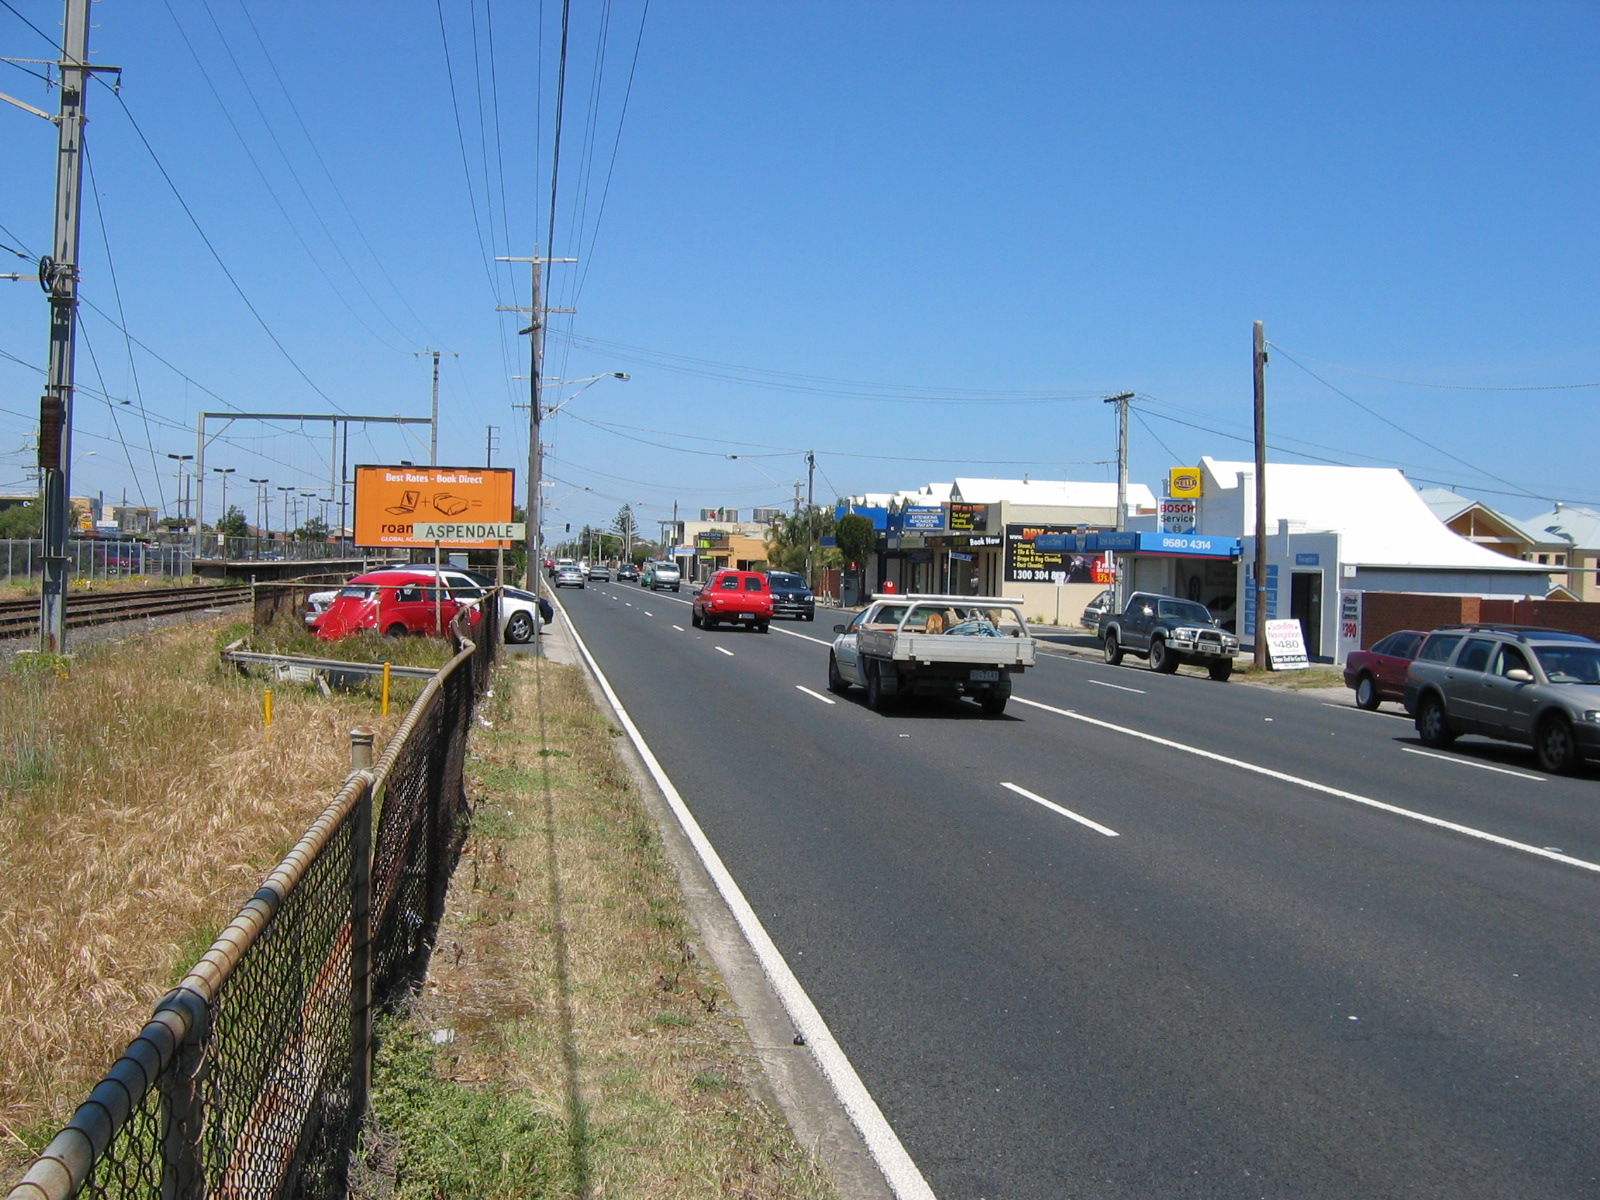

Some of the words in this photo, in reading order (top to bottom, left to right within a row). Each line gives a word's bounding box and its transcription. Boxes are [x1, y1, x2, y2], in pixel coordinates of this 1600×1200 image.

[385, 473, 403, 482] Best
[406, 473, 429, 483] Rates
[436, 474, 457, 484] Book
[459, 474, 483, 484] Direct
[1160, 504, 1195, 513] BOSCH
[1160, 514, 1194, 523] Service
[425, 525, 514, 538] ASPENDALE
[969, 537, 985, 546] Book
[986, 536, 1000, 546] Now
[1162, 538, 1188, 548] 9580
[1190, 540, 1212, 549] 4314
[1013, 570, 1033, 580] 1300
[1034, 570, 1049, 580] 304
[1270, 621, 1295, 631] Satellite
[1268, 631, 1300, 640] Navigation
[1273, 640, 1299, 649] $480
